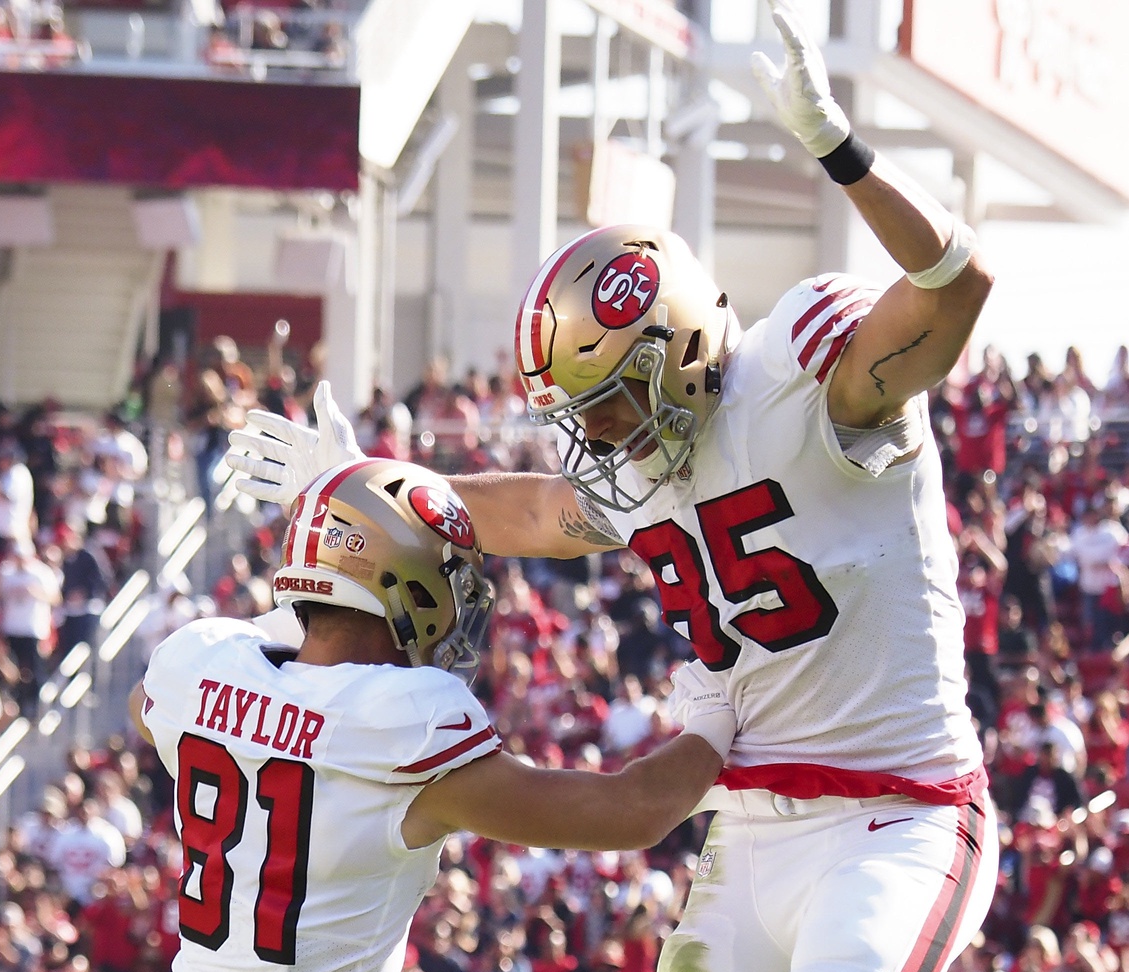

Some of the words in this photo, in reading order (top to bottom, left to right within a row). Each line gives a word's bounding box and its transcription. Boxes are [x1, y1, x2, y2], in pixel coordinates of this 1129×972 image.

[597, 261, 652, 312] SF
[274, 576, 333, 596] 49ERS
[628, 477, 839, 672] 85
[195, 678, 325, 760] TAYLOR
[177, 731, 316, 966] 81
